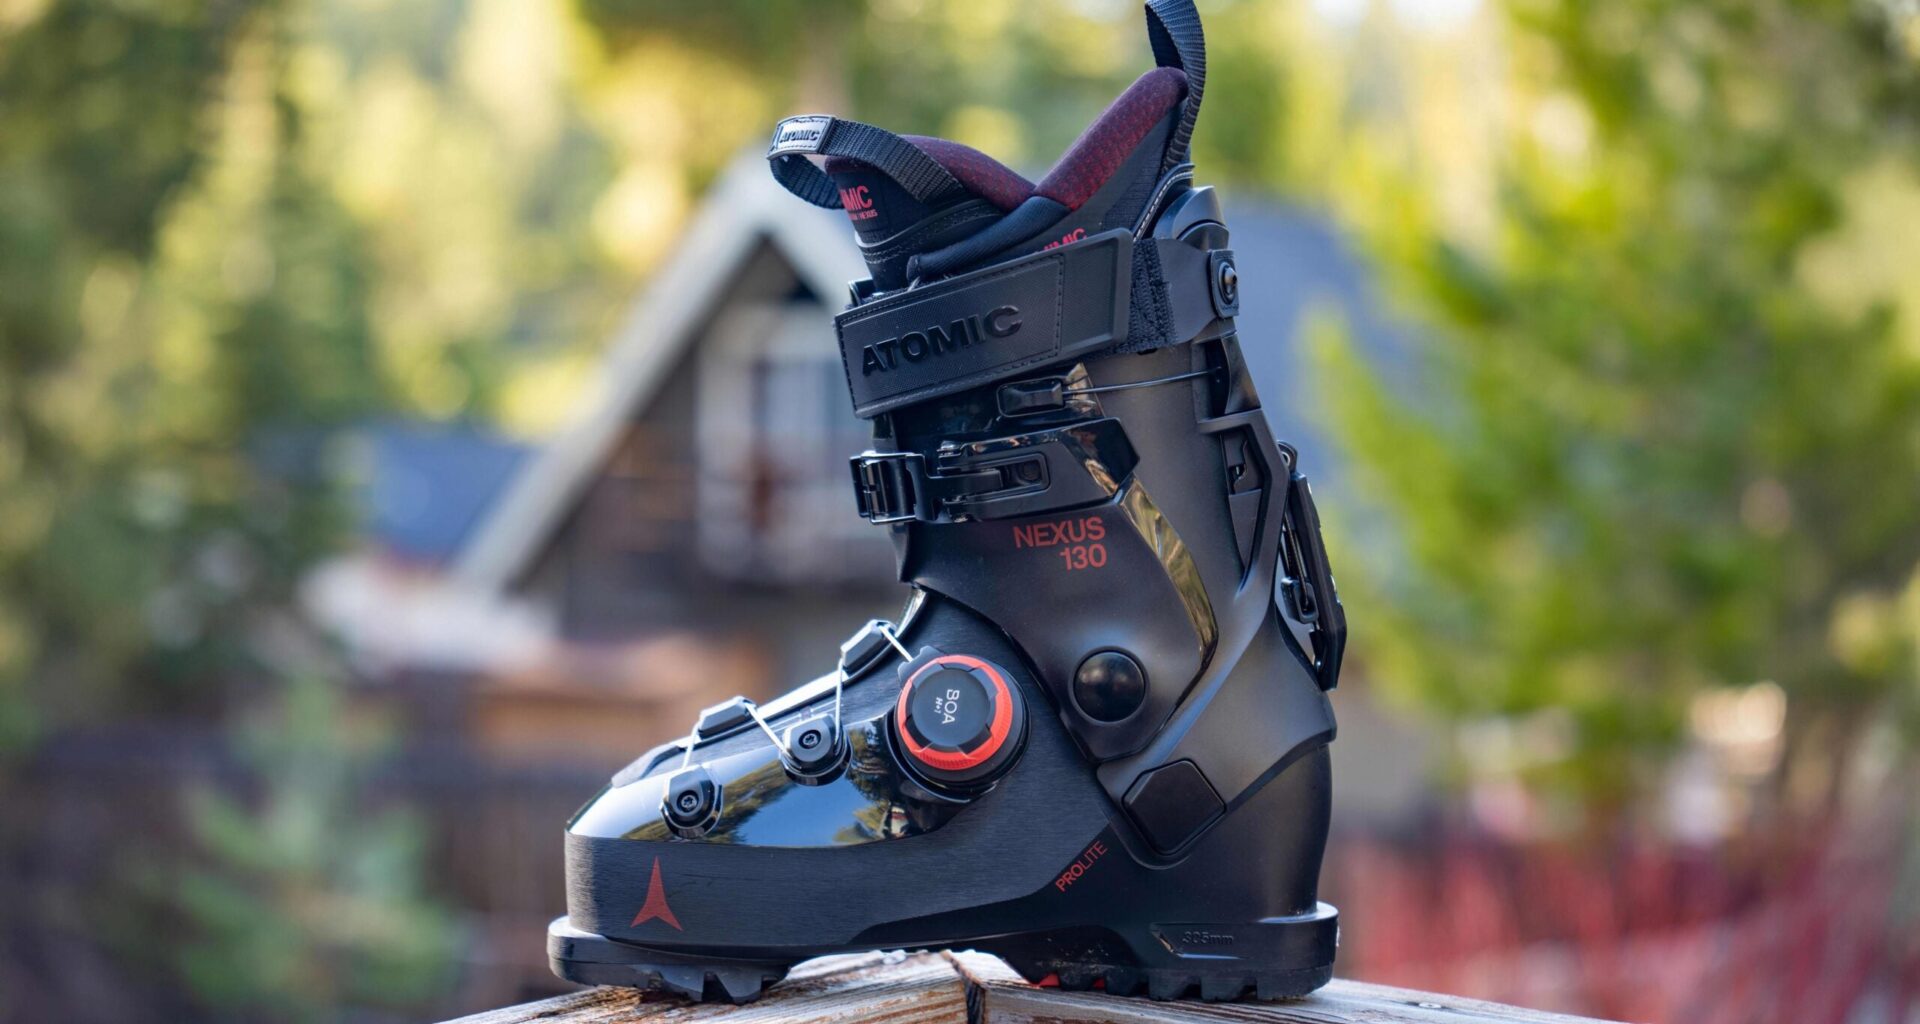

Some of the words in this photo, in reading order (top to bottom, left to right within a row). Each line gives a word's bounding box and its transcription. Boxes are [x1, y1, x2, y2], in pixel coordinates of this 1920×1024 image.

[779, 130, 820, 143] ATOMIC
[840, 185, 873, 211] MIC
[862, 304, 1023, 377] ATOMIC
[1013, 516, 1106, 548] NEXUS
[1060, 543, 1107, 571] 130
[942, 689, 960, 725] BOA
[1055, 840, 1108, 892] PROLITE
